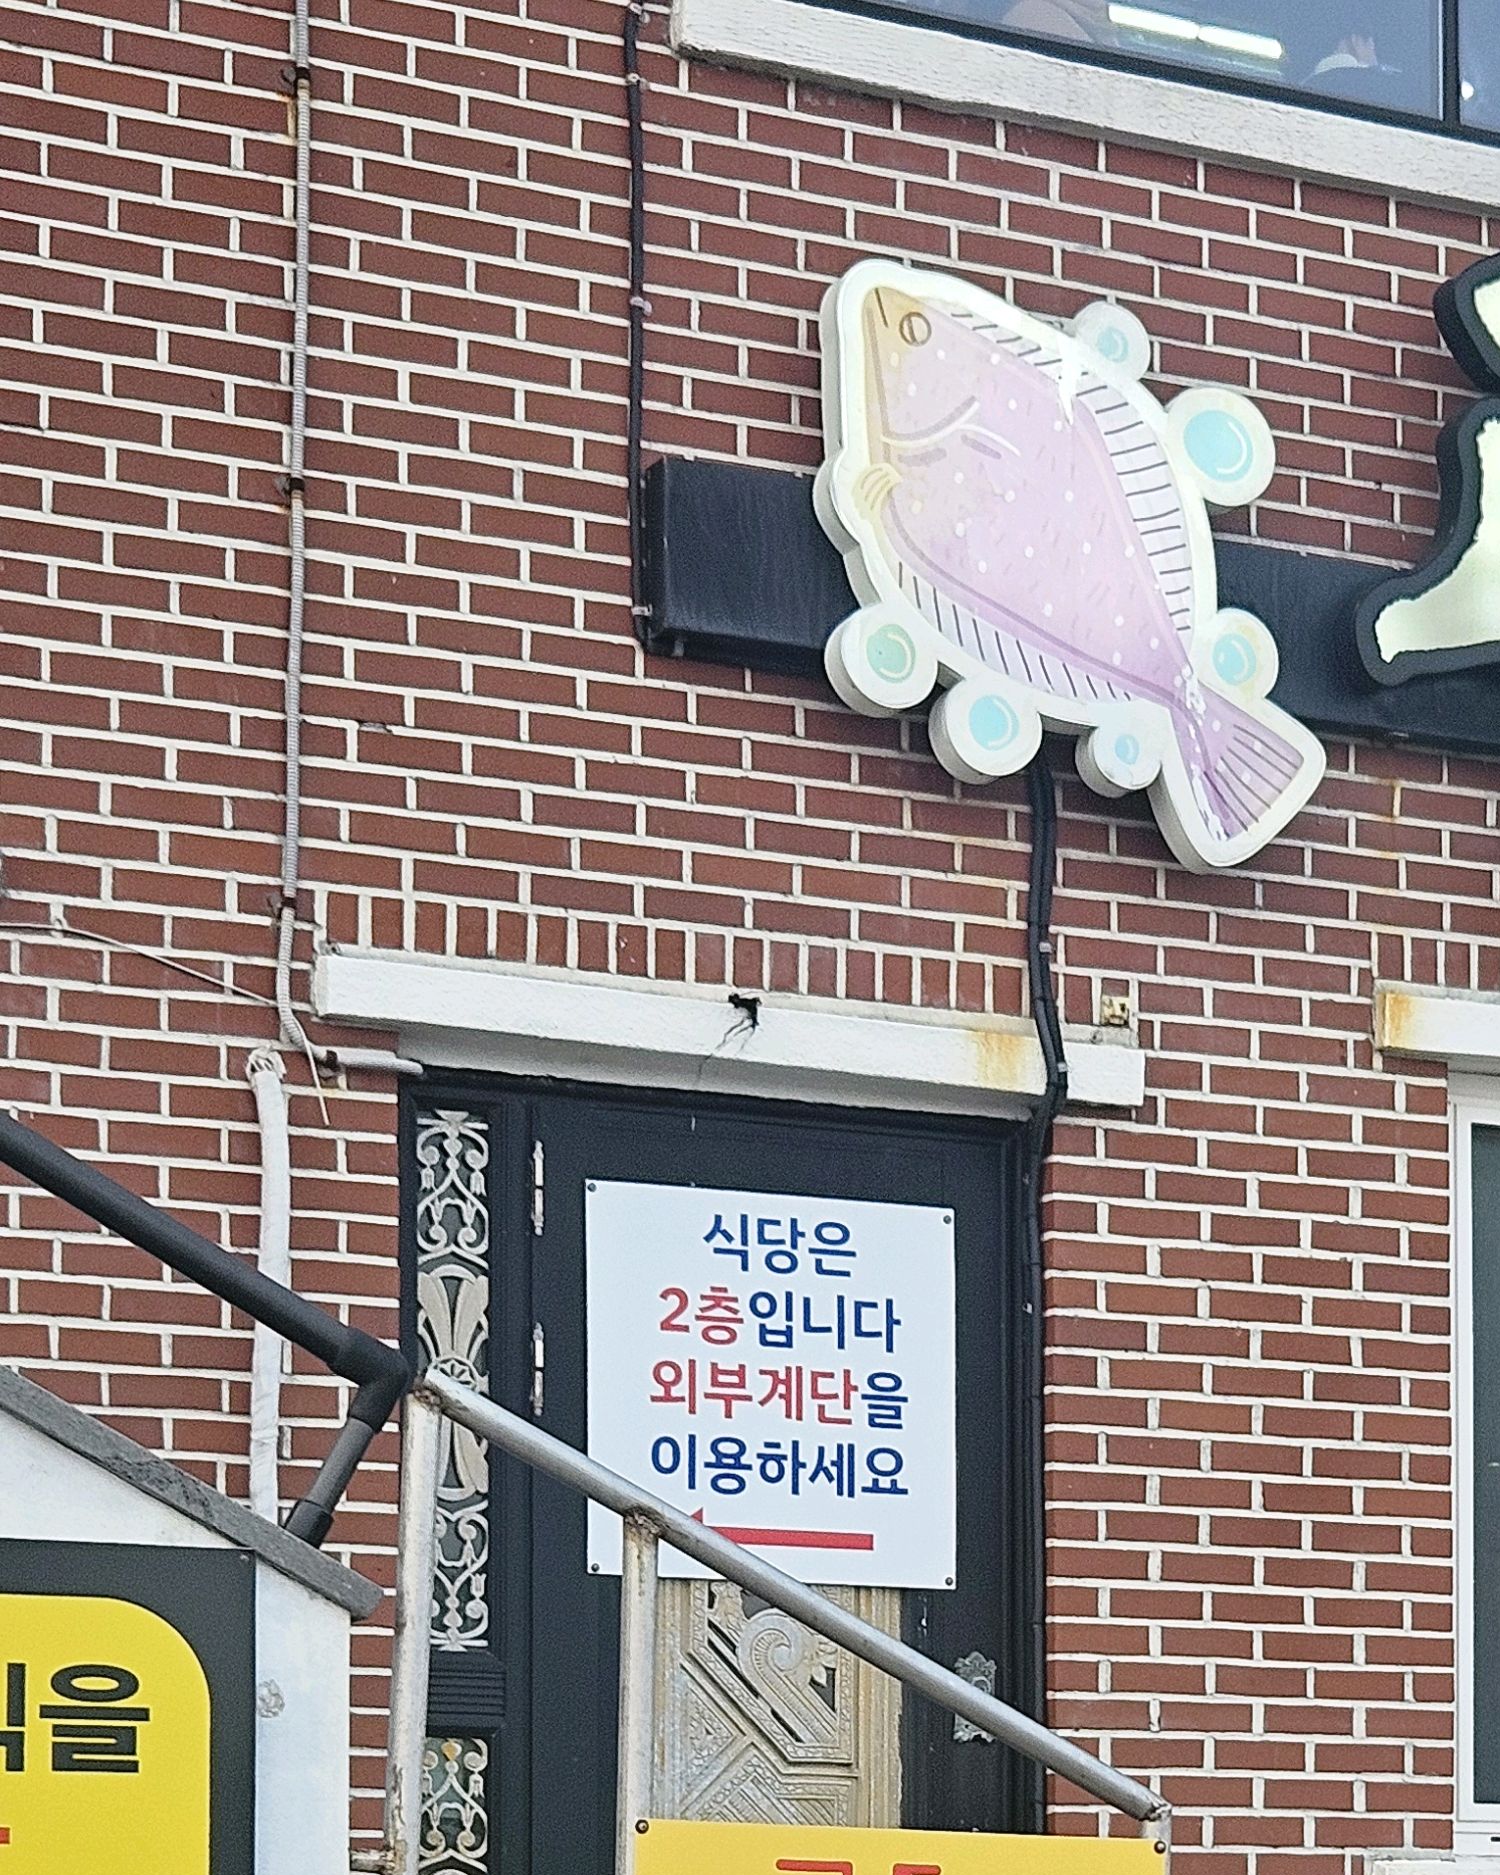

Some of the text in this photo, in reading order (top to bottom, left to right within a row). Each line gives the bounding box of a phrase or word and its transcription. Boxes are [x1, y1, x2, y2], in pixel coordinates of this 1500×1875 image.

[702, 1213, 857, 1278] 식당은
[657, 1285, 903, 1354] 2층입니다
[649, 1358, 910, 1430] 외부계단을
[650, 1433, 910, 1499] 이용하세요
